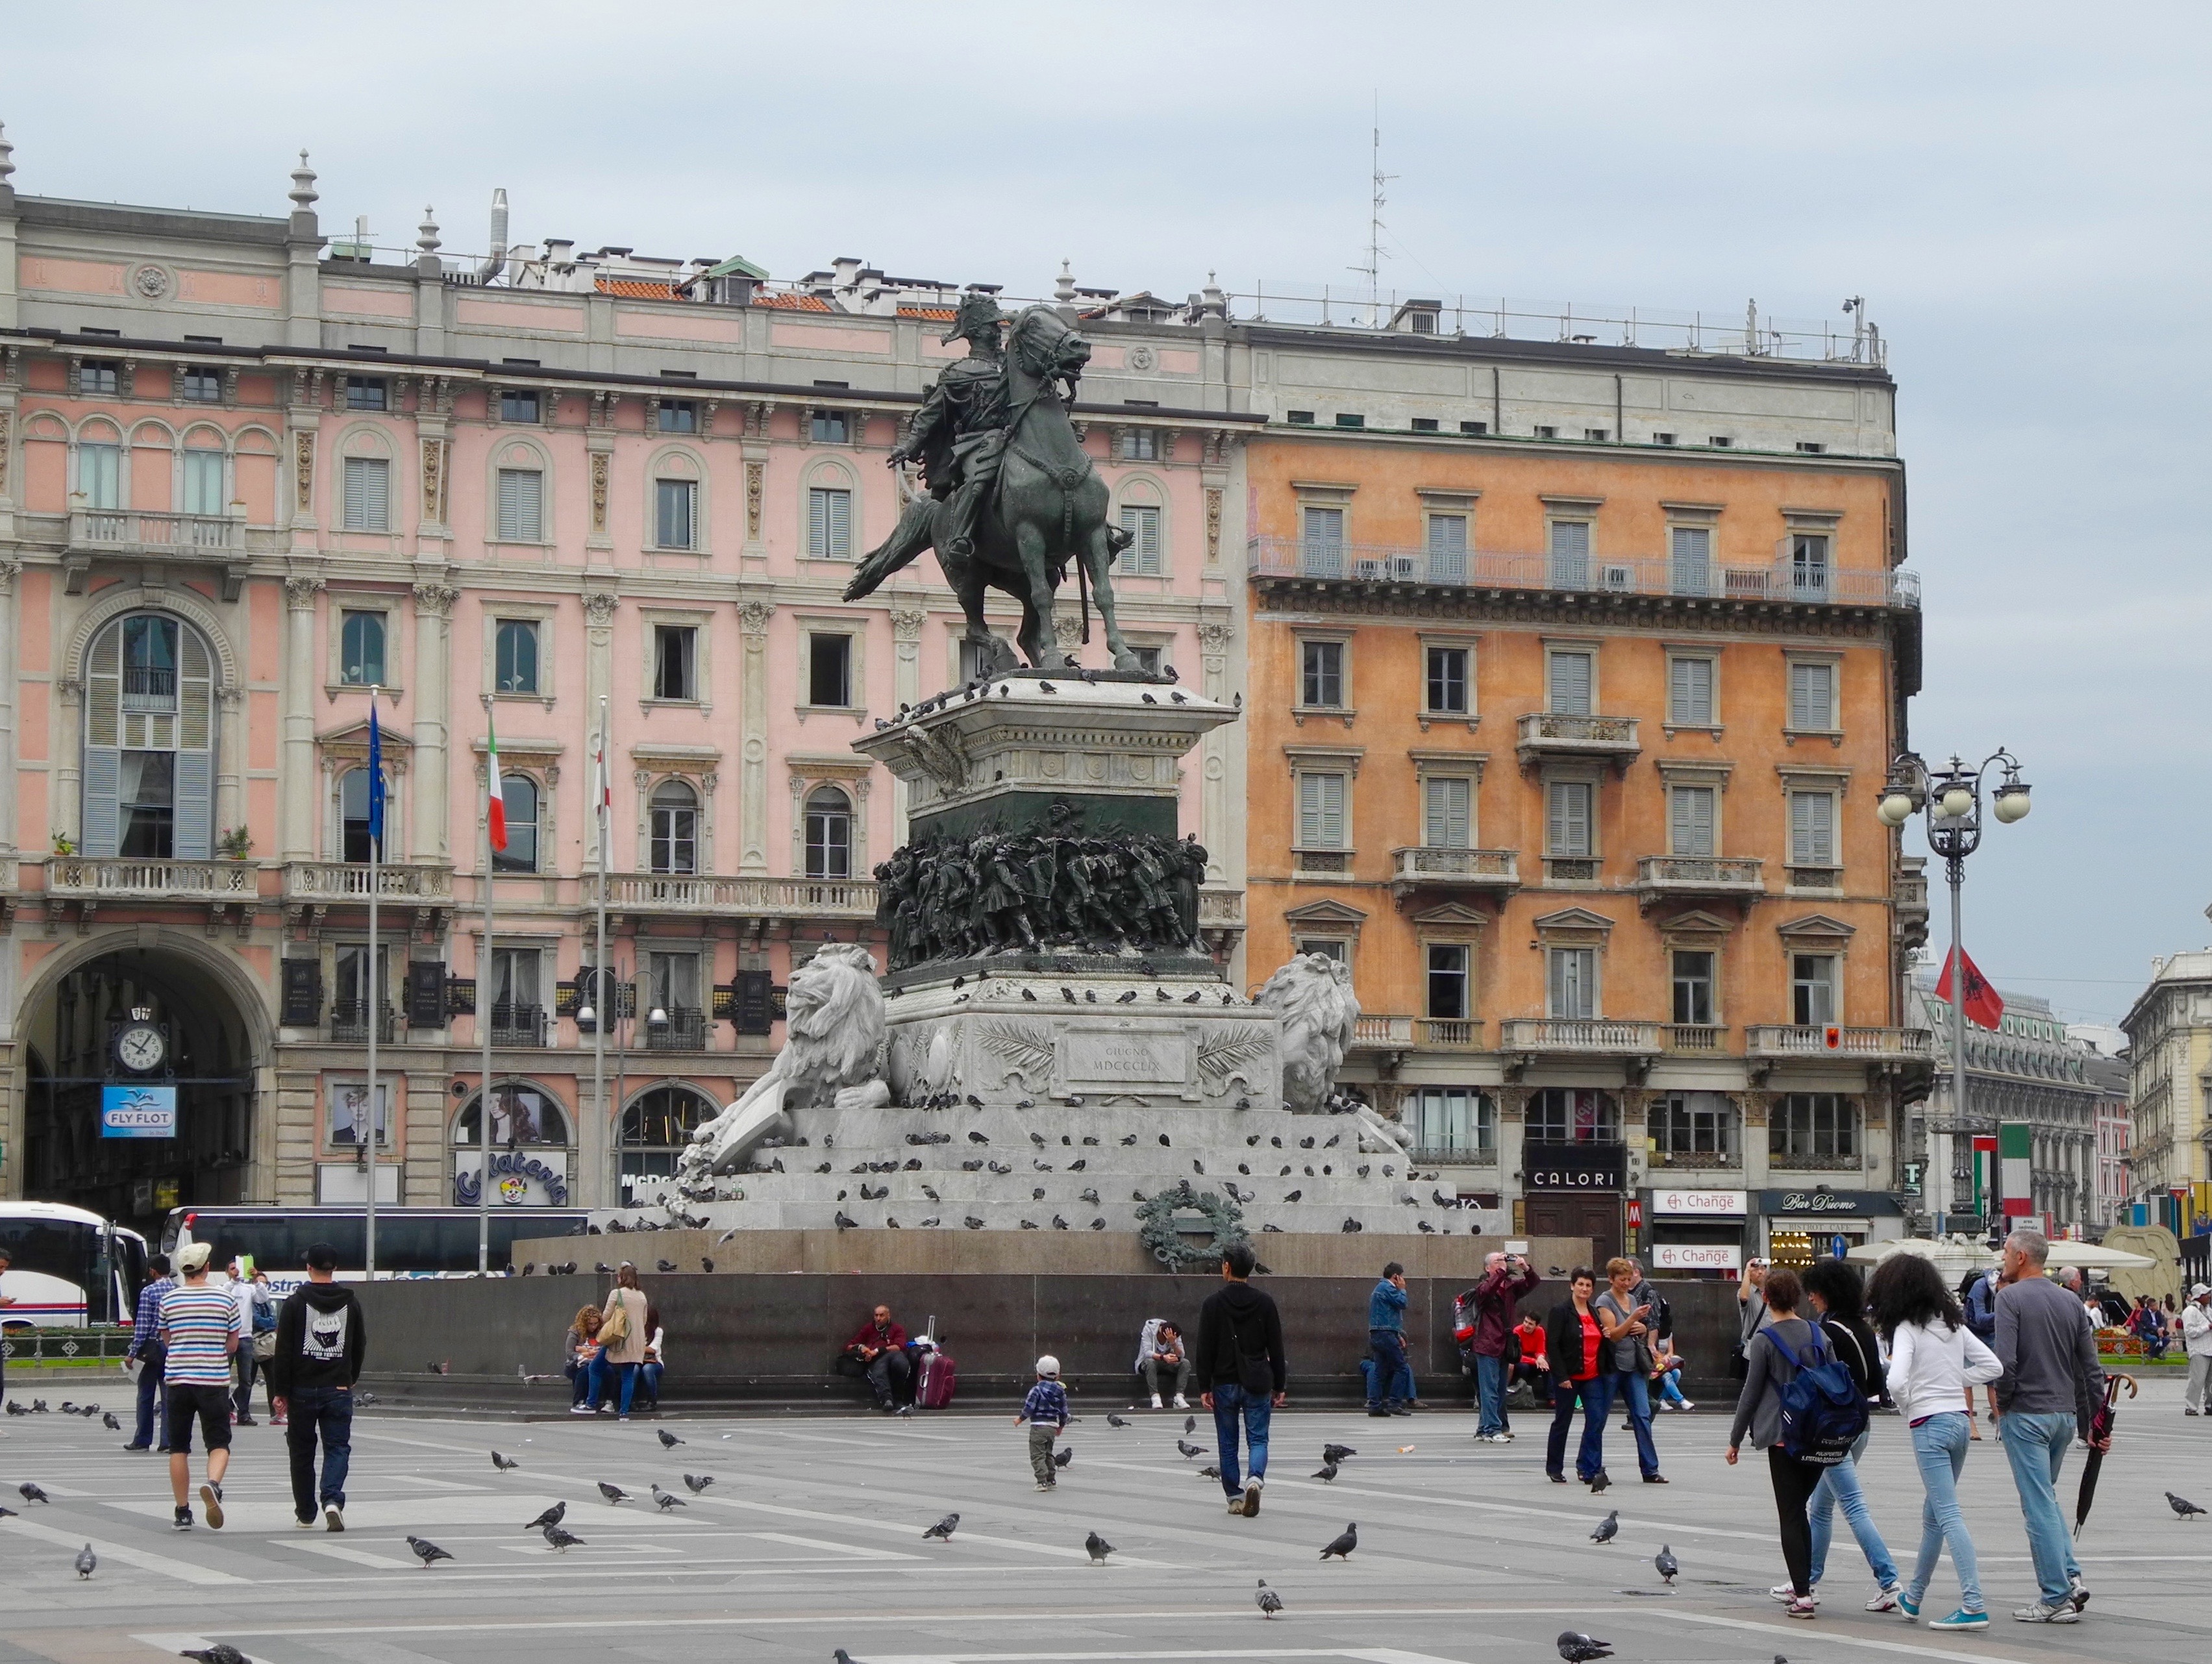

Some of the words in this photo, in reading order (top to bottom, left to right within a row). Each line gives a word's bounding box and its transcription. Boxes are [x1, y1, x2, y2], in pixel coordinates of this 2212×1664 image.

[1093, 1061, 1160, 1071] MDCCCLIX
[112, 1113, 132, 1123] FLY
[136, 1113, 168, 1123] FLOT
[1534, 1173, 1613, 1186] CALORI
[1687, 1195, 1734, 1210] Change
[1782, 1193, 1811, 1210] Bar
[1811, 1194, 1857, 1211] Duomo
[1629, 1206, 1640, 1222] M
[1682, 1250, 1728, 1265] Change
